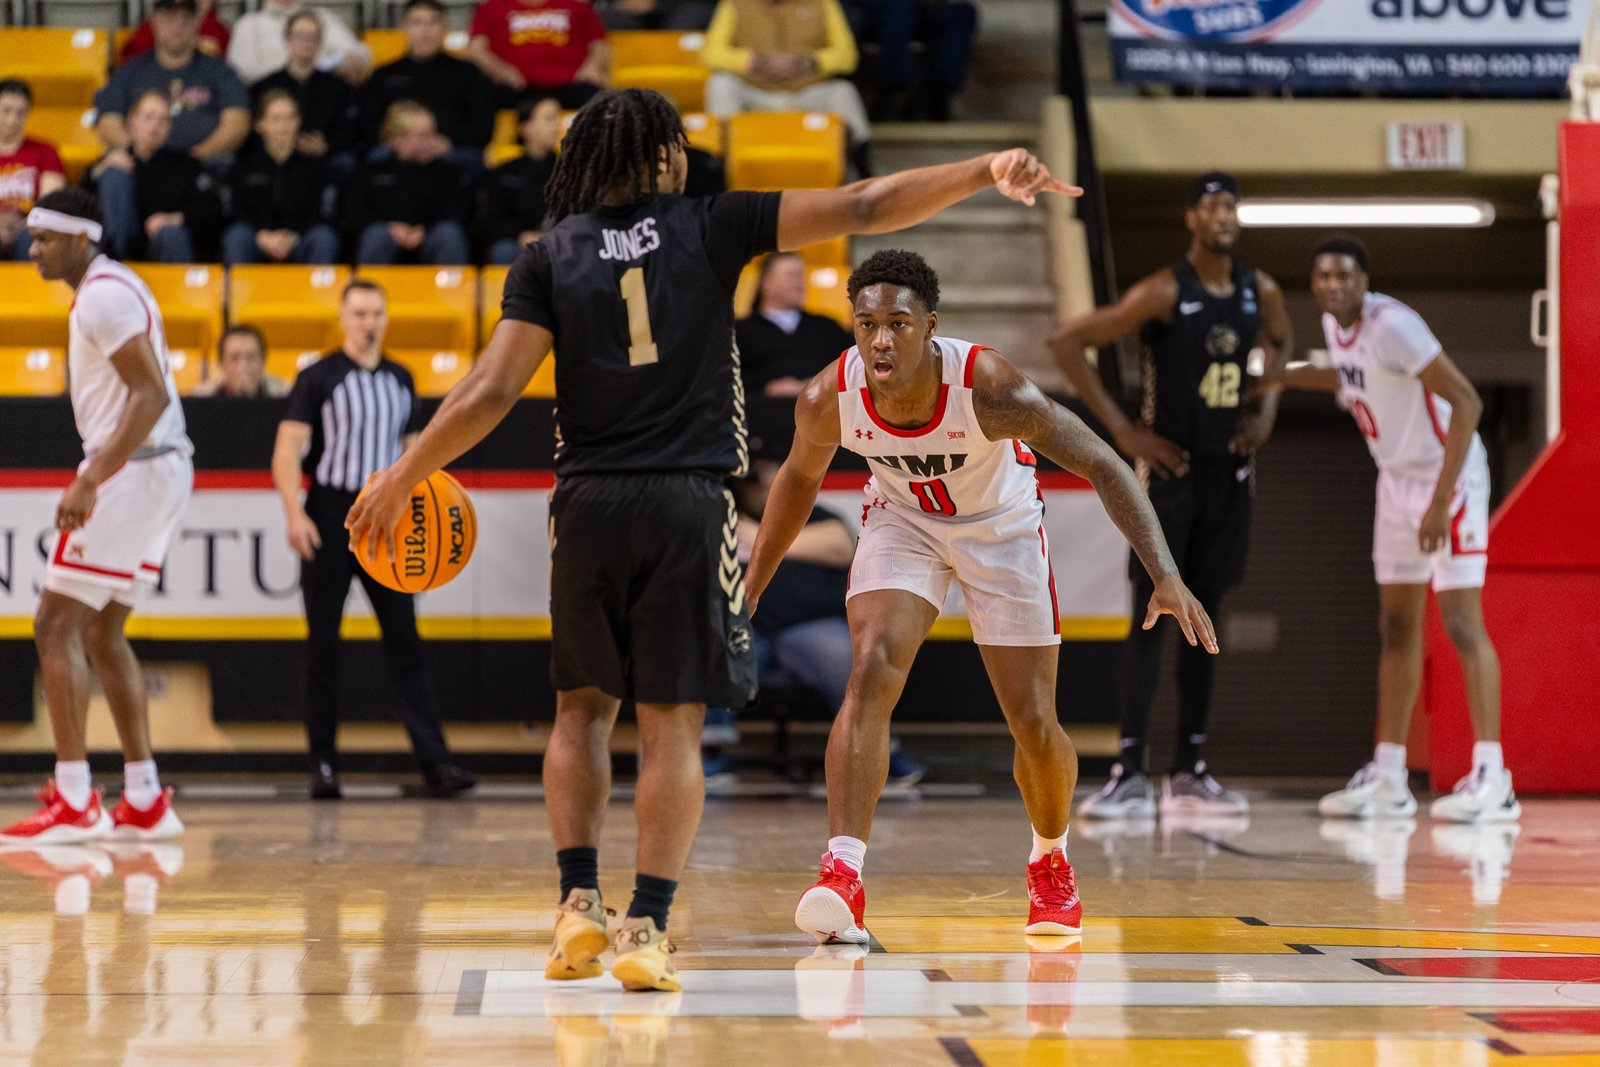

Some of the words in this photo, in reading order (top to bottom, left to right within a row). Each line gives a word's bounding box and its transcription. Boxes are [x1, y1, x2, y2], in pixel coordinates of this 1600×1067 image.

[1398, 124, 1449, 160] EXIT
[599, 217, 660, 261] JONES
[619, 267, 659, 367] 1
[1199, 361, 1241, 408] 42
[908, 477, 957, 517] 0
[404, 494, 427, 578] Wilson
[447, 504, 465, 565] NCAA
